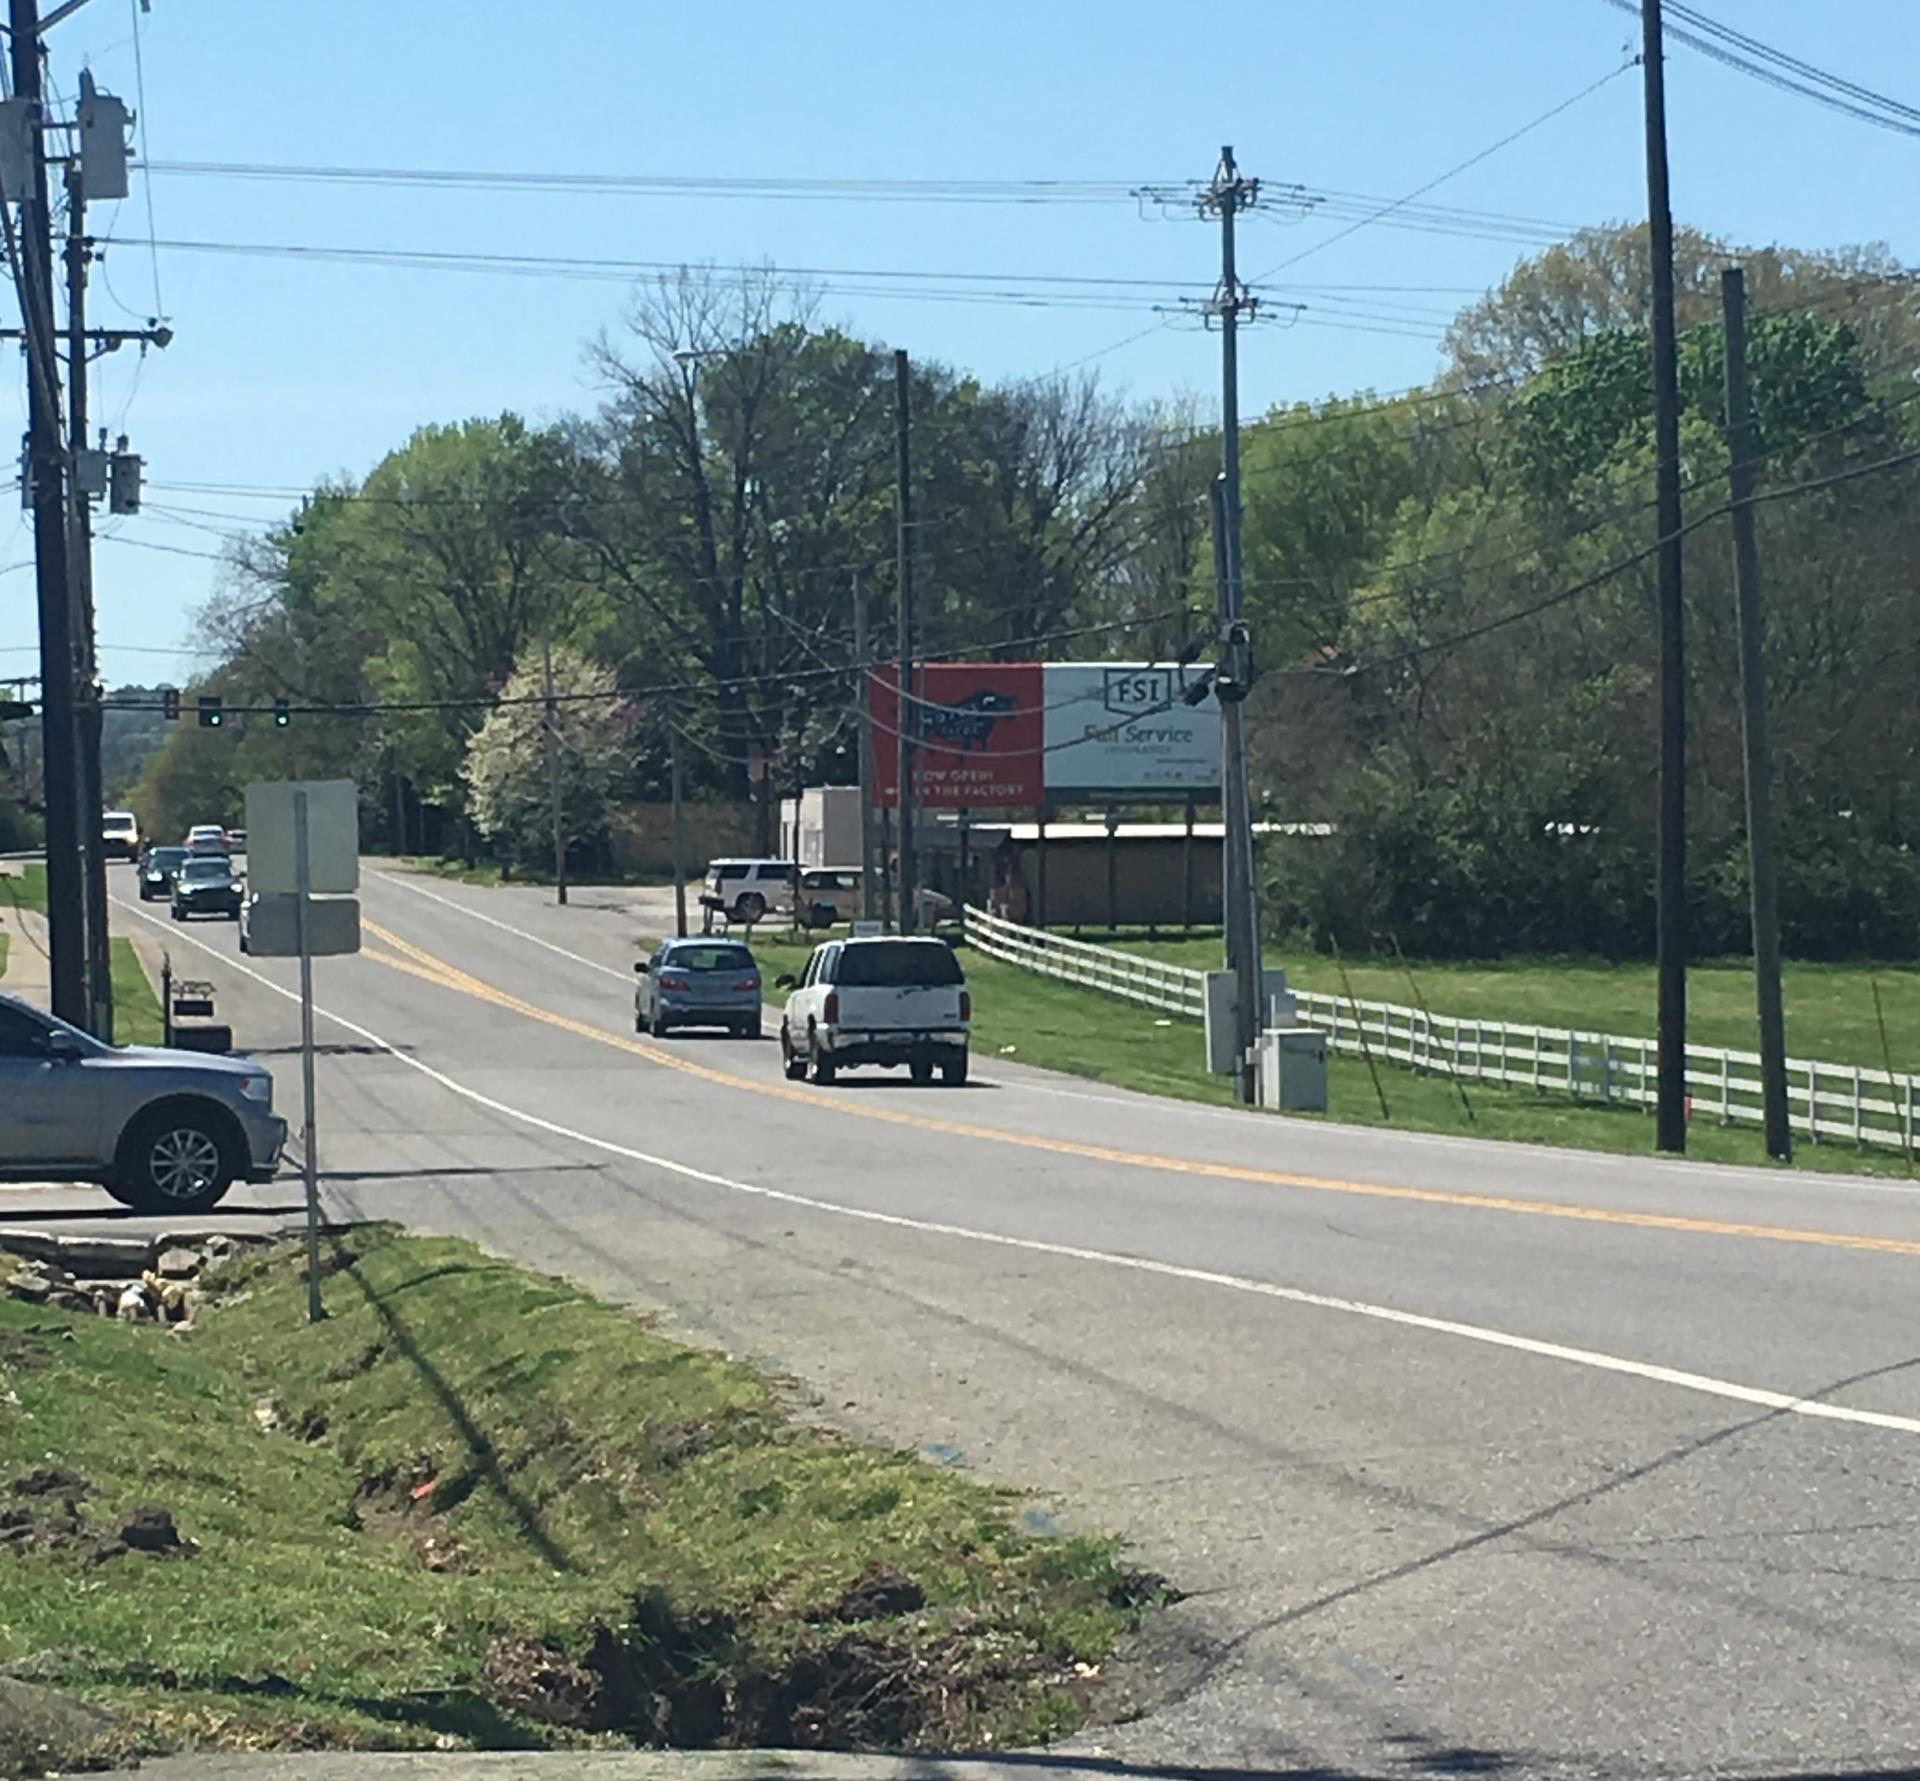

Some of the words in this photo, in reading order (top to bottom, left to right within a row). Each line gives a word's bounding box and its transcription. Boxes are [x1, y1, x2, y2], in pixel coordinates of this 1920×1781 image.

[1119, 679, 1160, 702] FSI
[1124, 724, 1193, 743] Service
[965, 785, 1023, 798] FACTORY
